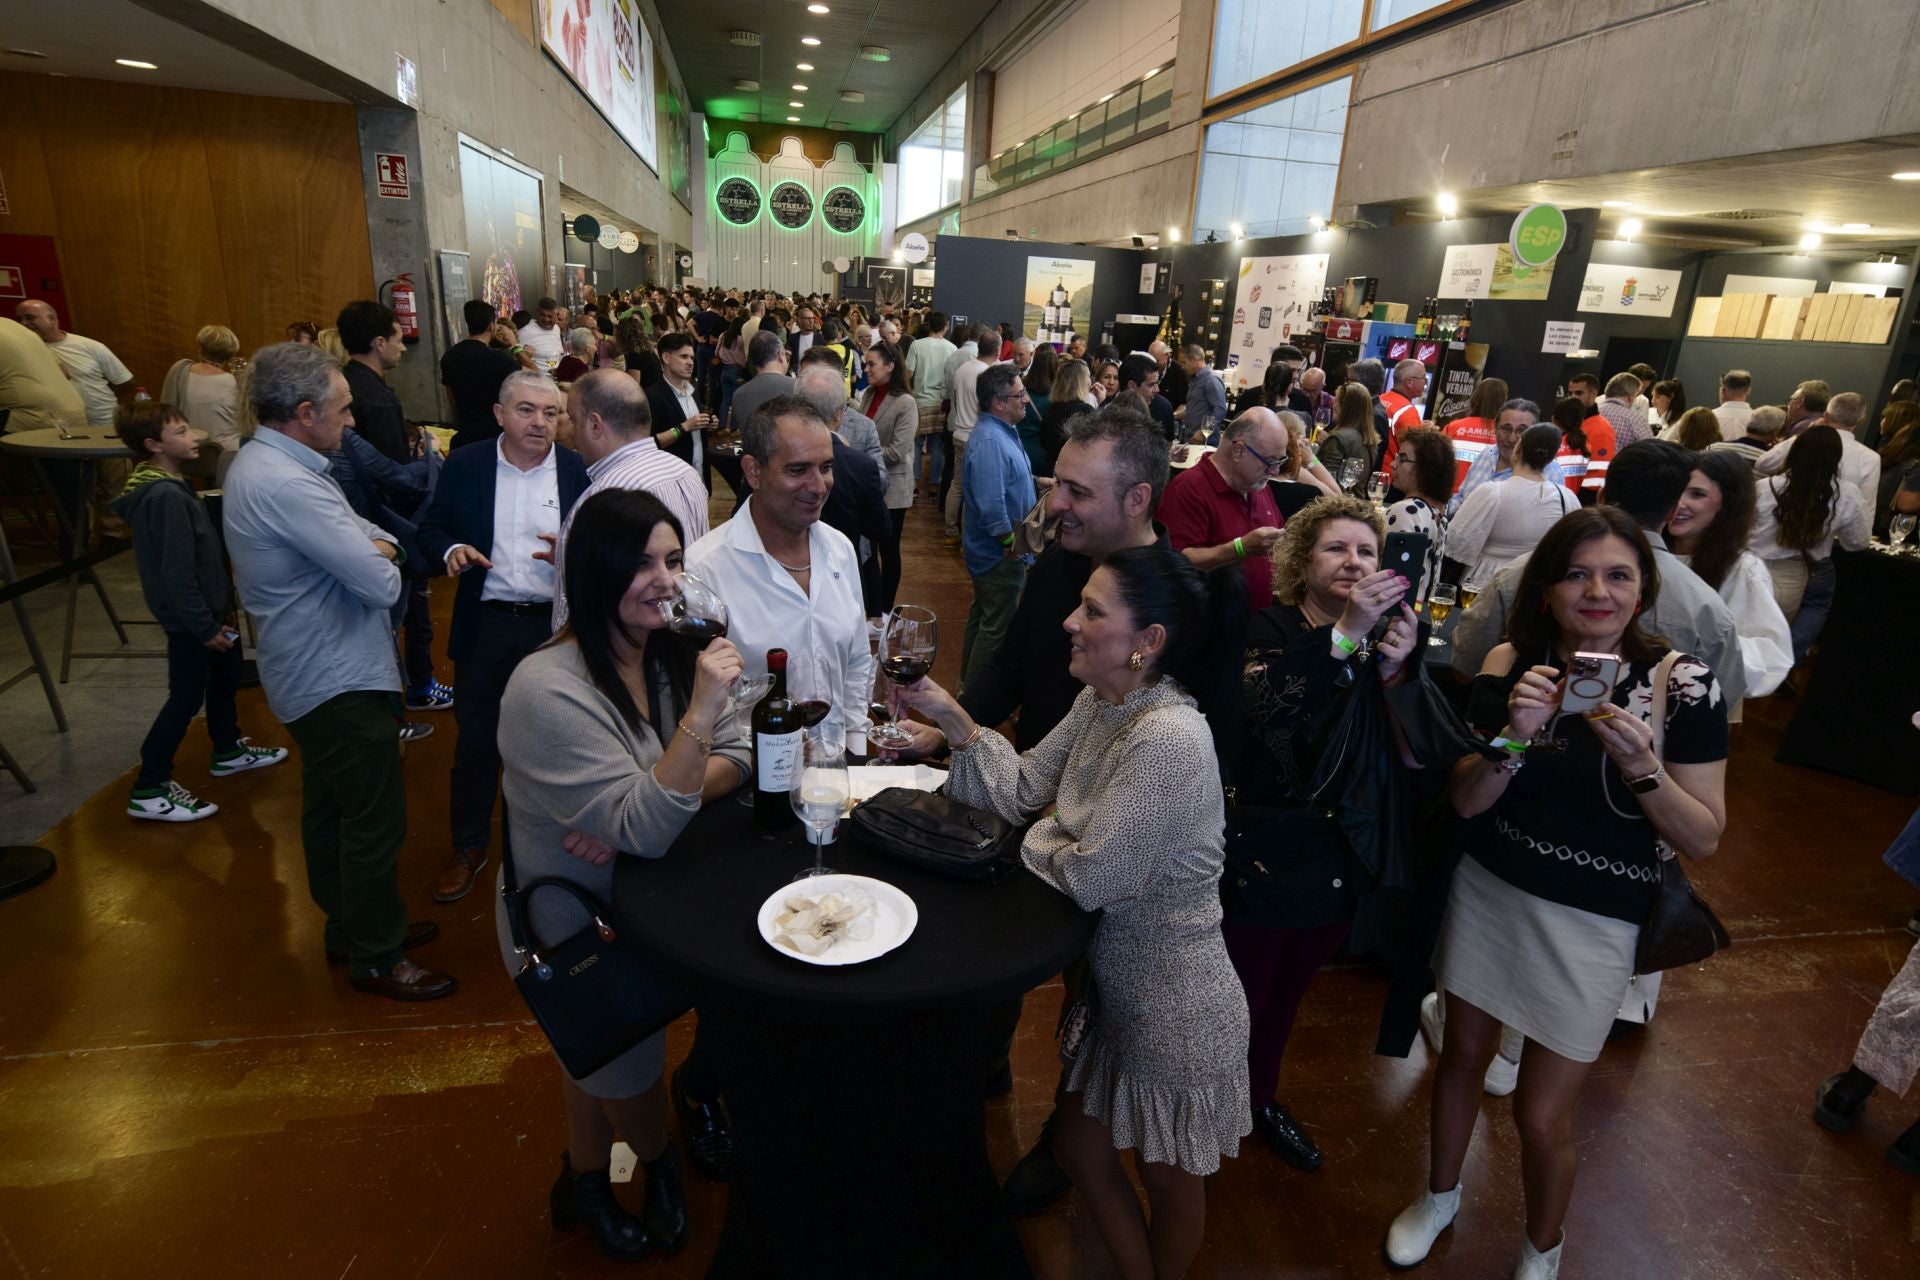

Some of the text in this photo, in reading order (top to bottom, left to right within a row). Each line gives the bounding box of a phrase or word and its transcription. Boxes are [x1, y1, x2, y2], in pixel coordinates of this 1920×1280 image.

[380, 186, 408, 196] EXTINTOR
[720, 197, 758, 207] ESTRELLA
[773, 201, 810, 210] ESTRELLA
[825, 206, 862, 216] ESTRELLA
[1519, 225, 1561, 247] ESP
[1449, 370, 1469, 383] TINTO
[1446, 382, 1473, 395] VERANO
